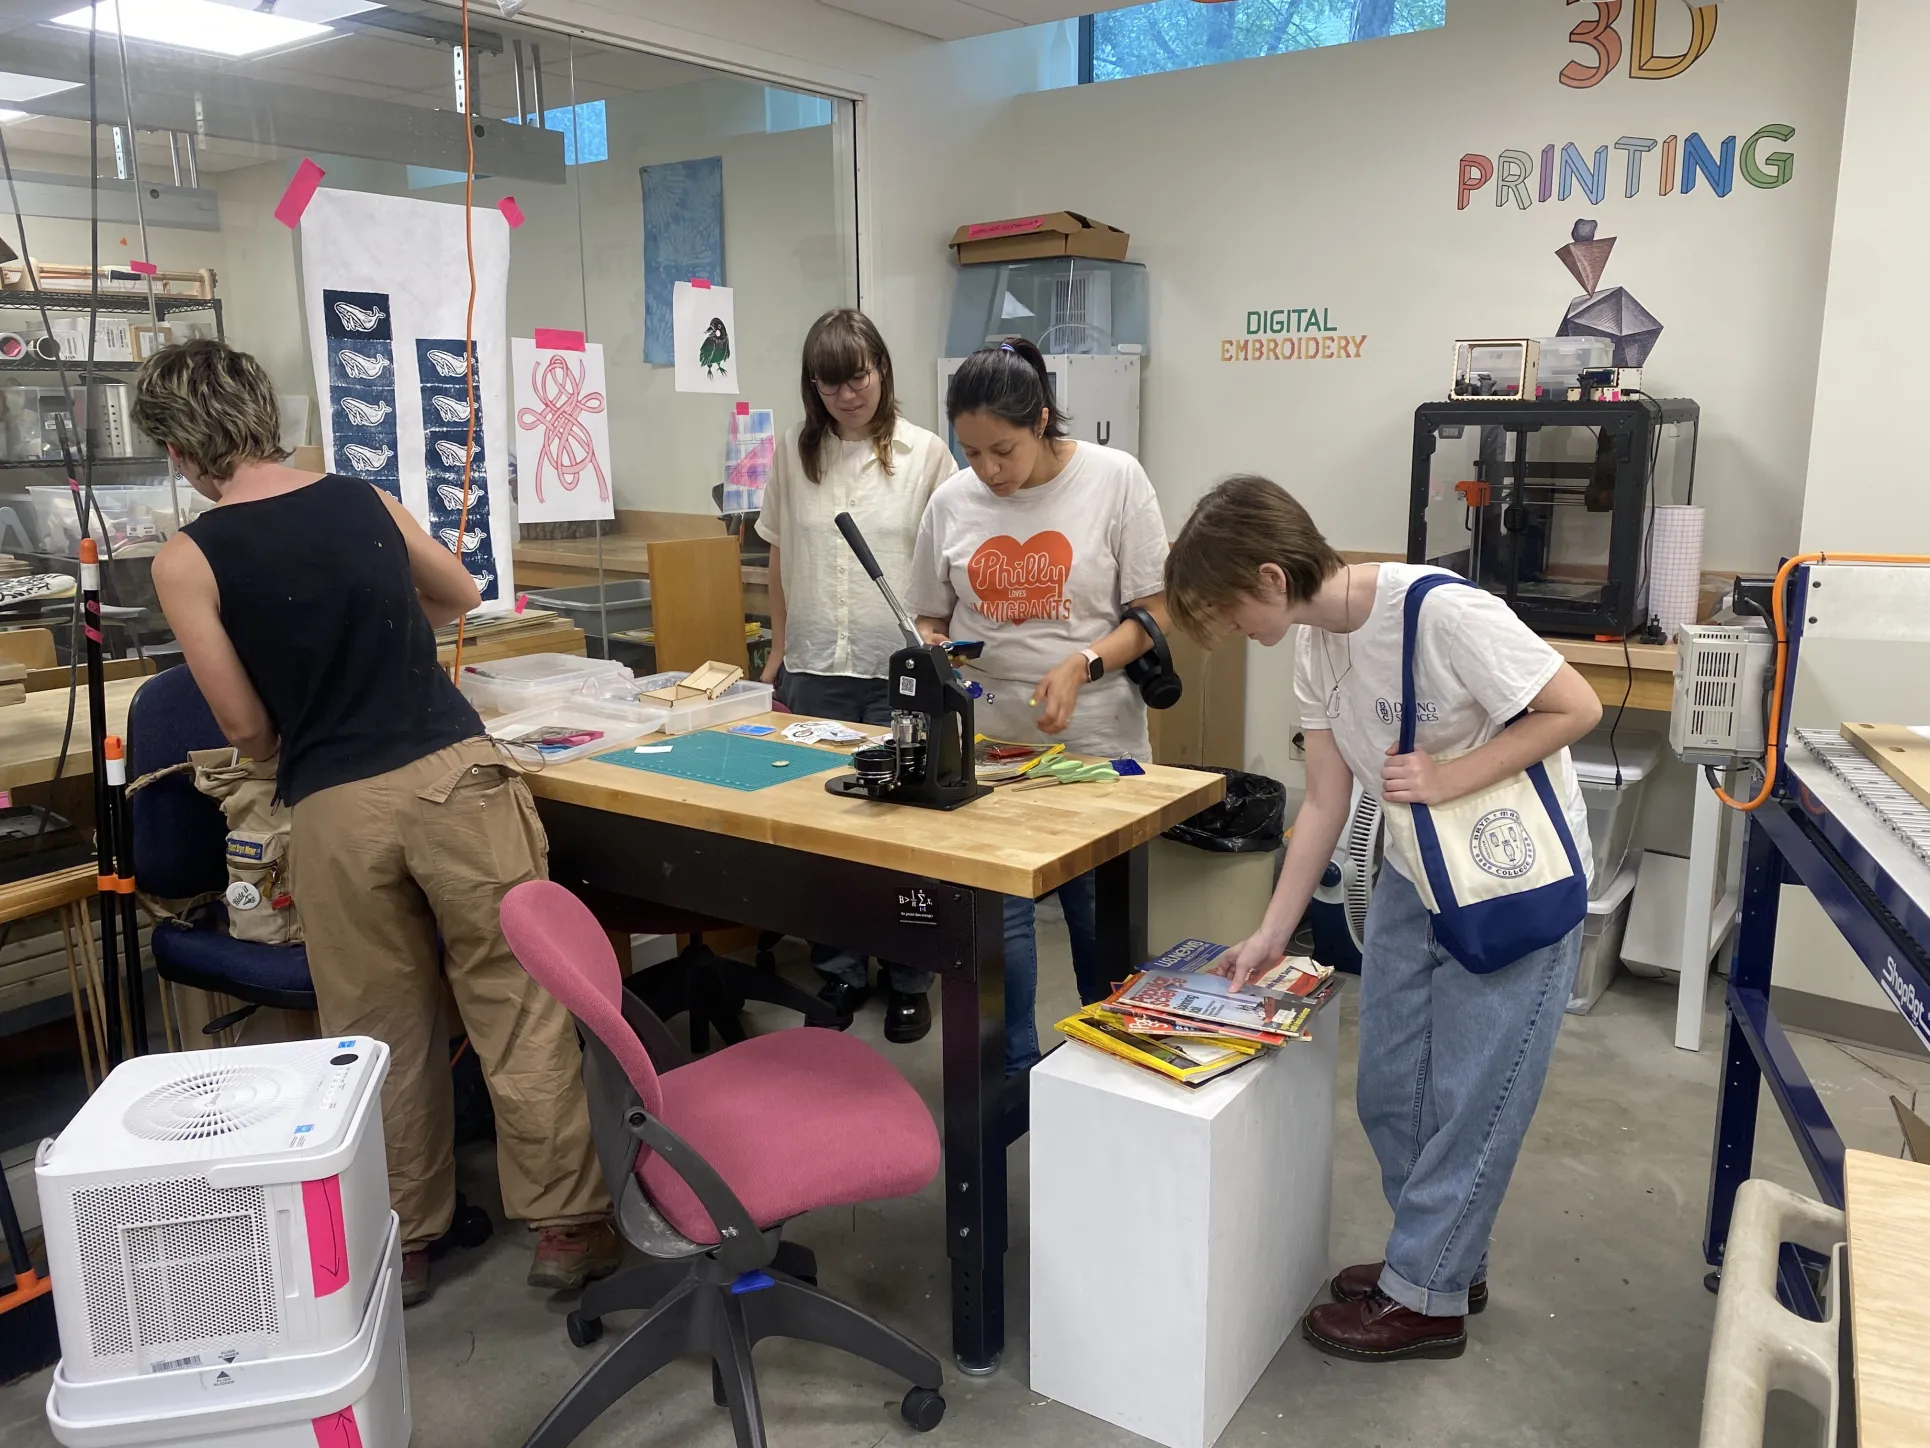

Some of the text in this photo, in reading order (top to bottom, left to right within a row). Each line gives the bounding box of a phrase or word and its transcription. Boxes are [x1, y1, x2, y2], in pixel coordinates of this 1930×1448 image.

[1559, 0, 1717, 89] 3D
[1458, 124, 1795, 210] PRINTING
[1246, 308, 1338, 335] DIGITAL
[1220, 335, 1367, 361] EMBROIDERY
[972, 549, 1066, 600] Philly
[1008, 590, 1026, 598] LOVES
[971, 599, 1072, 623] MMIGRANTS
[1394, 702, 1436, 713] DNG
[1396, 713, 1439, 722] SICES
[1474, 817, 1491, 840] BRYN
[1496, 861, 1531, 876] COLLEGE
[1882, 956, 1925, 1020] ShopBot
